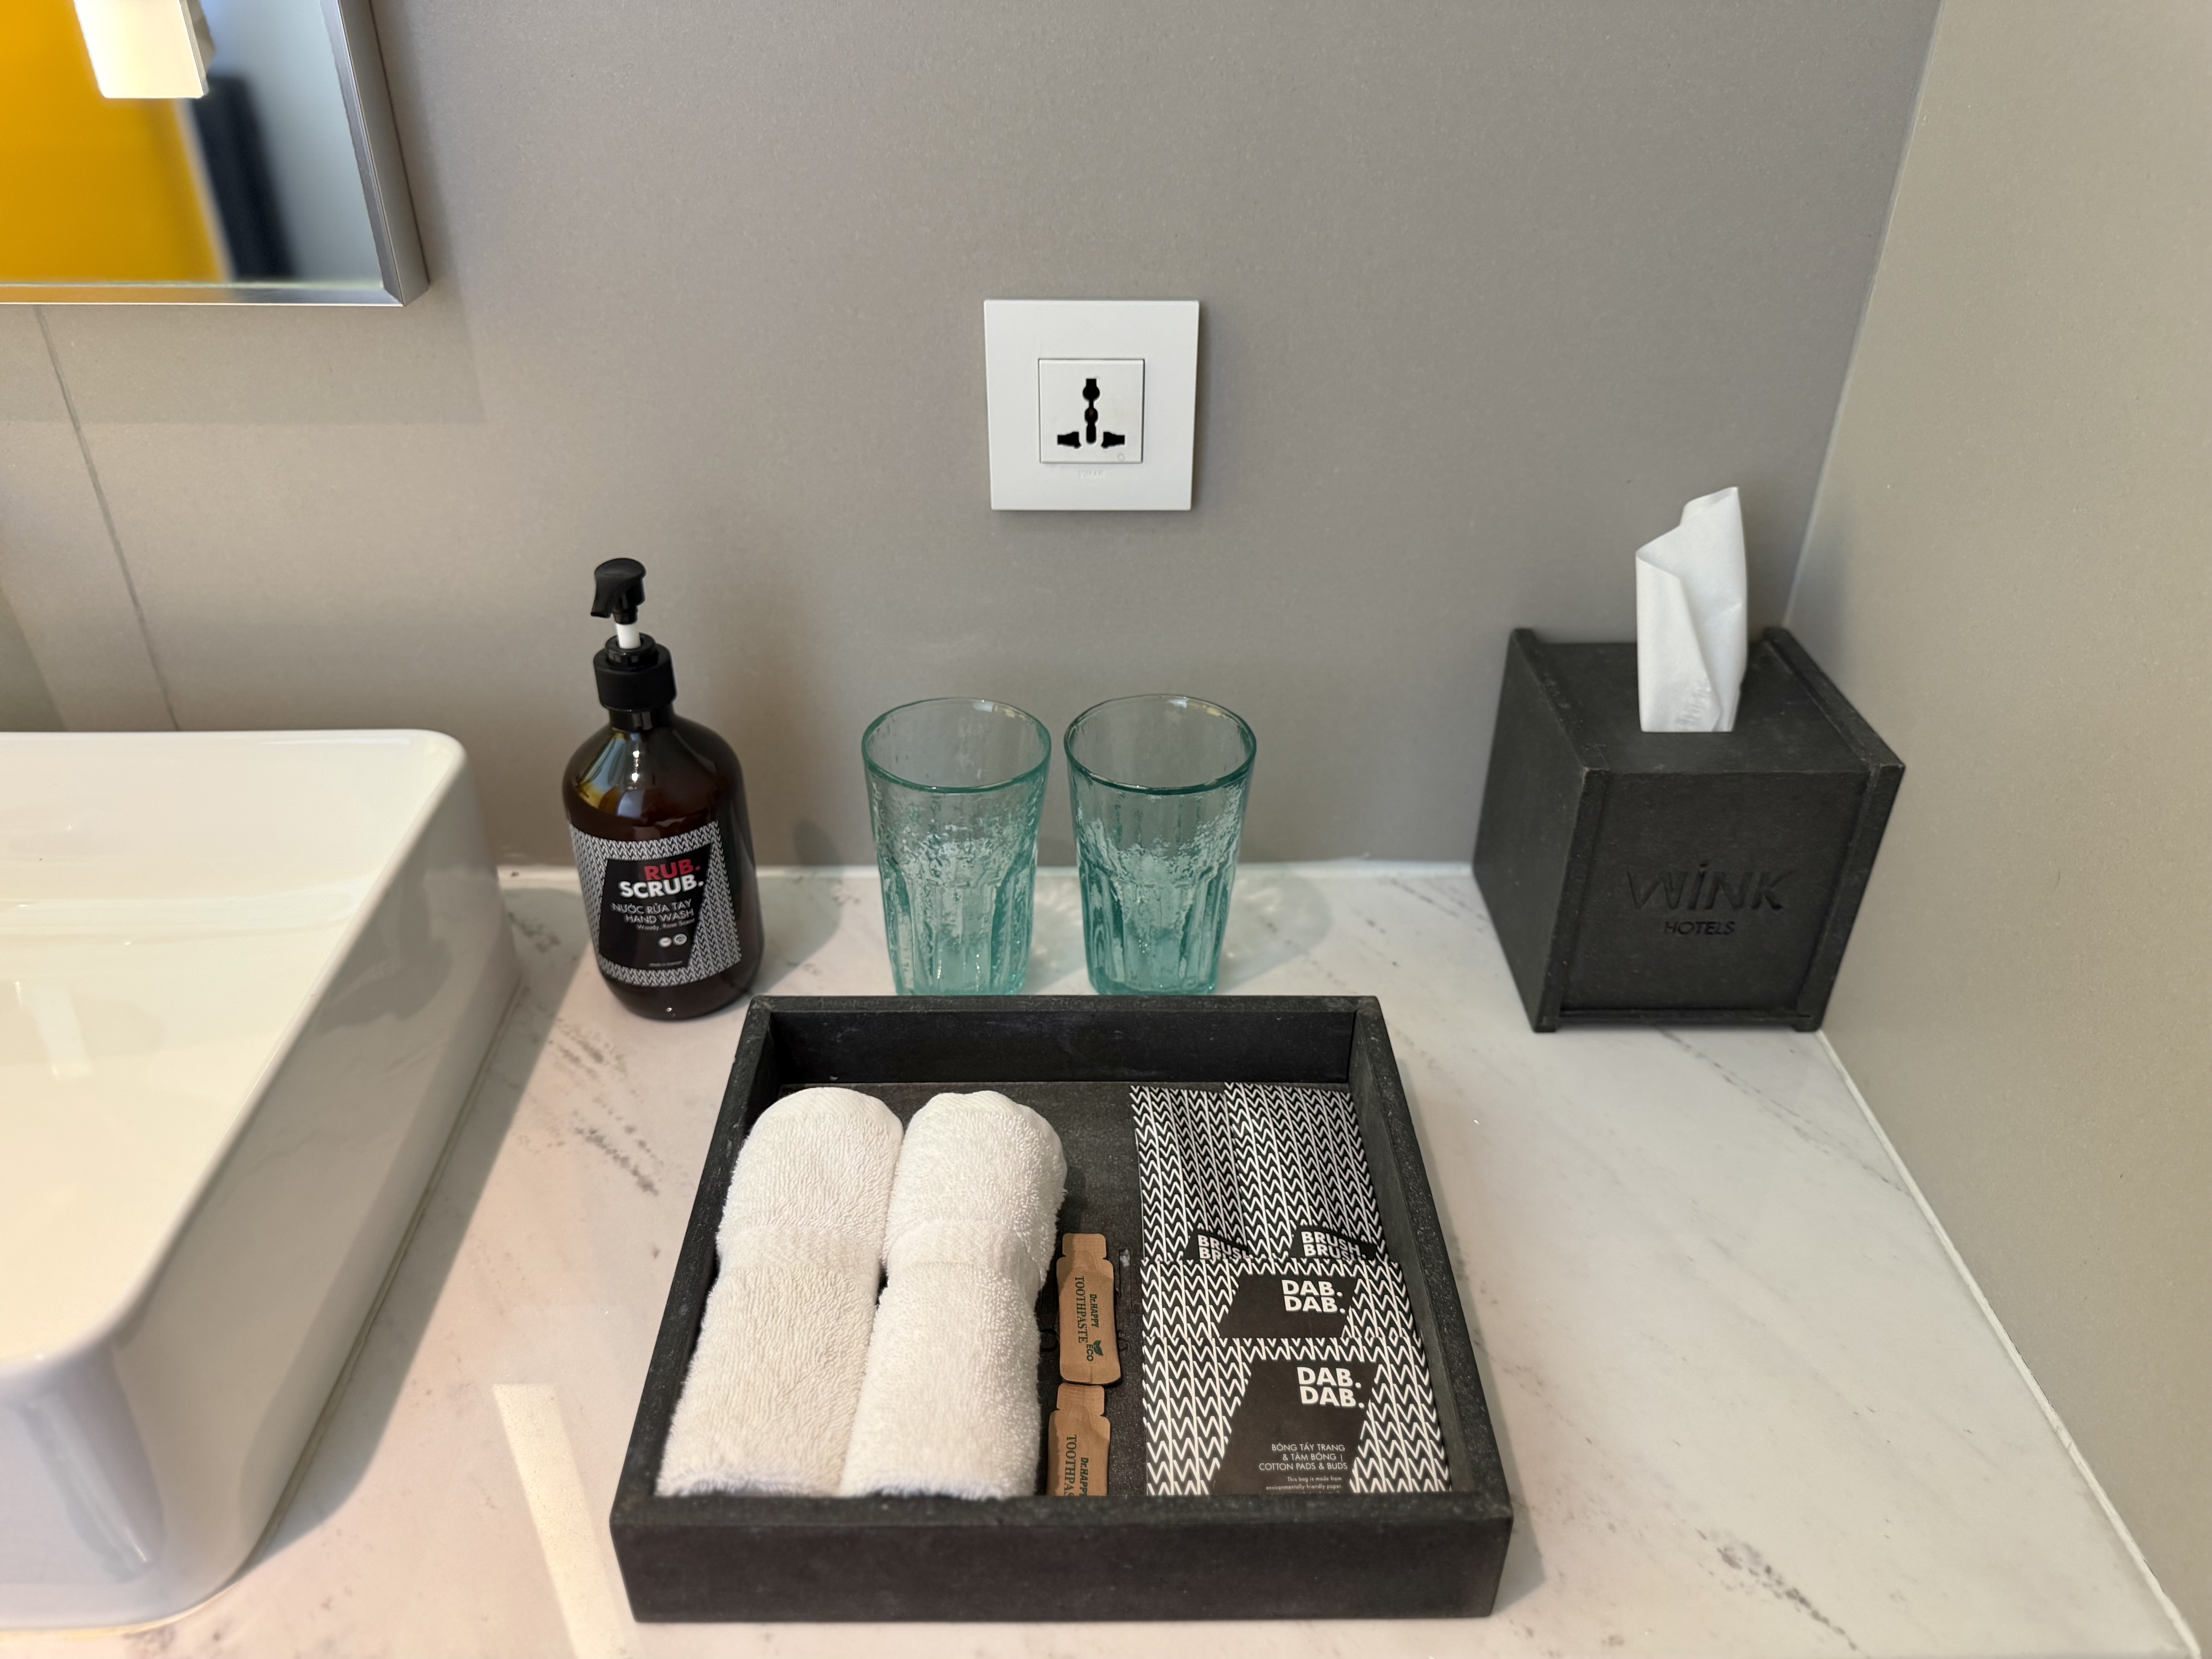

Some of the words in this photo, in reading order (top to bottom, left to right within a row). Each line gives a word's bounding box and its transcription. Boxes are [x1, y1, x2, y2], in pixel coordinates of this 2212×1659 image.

[644, 859, 700, 881] RUB.
[618, 874, 704, 898] SCRUB.
[671, 898, 692, 910] TAY
[624, 914, 657, 924] HAND
[659, 908, 694, 922] WASH
[1664, 921, 1735, 935] HOTELS
[1301, 1231, 1366, 1259] BRUSH.
[1282, 1279, 1343, 1297] DAB.
[1075, 1276, 1088, 1343] TOOTHPASTE
[1090, 1294, 1099, 1328] Dr.HAPPY
[1284, 1296, 1345, 1314] DAB.
[1297, 1367, 1362, 1389] DAB.
[1300, 1386, 1365, 1408] DAB.
[1272, 1443, 1297, 1451] BÔNG
[1291, 1452, 1308, 1461] TĂM
[1311, 1452, 1336, 1461] BÔNG
